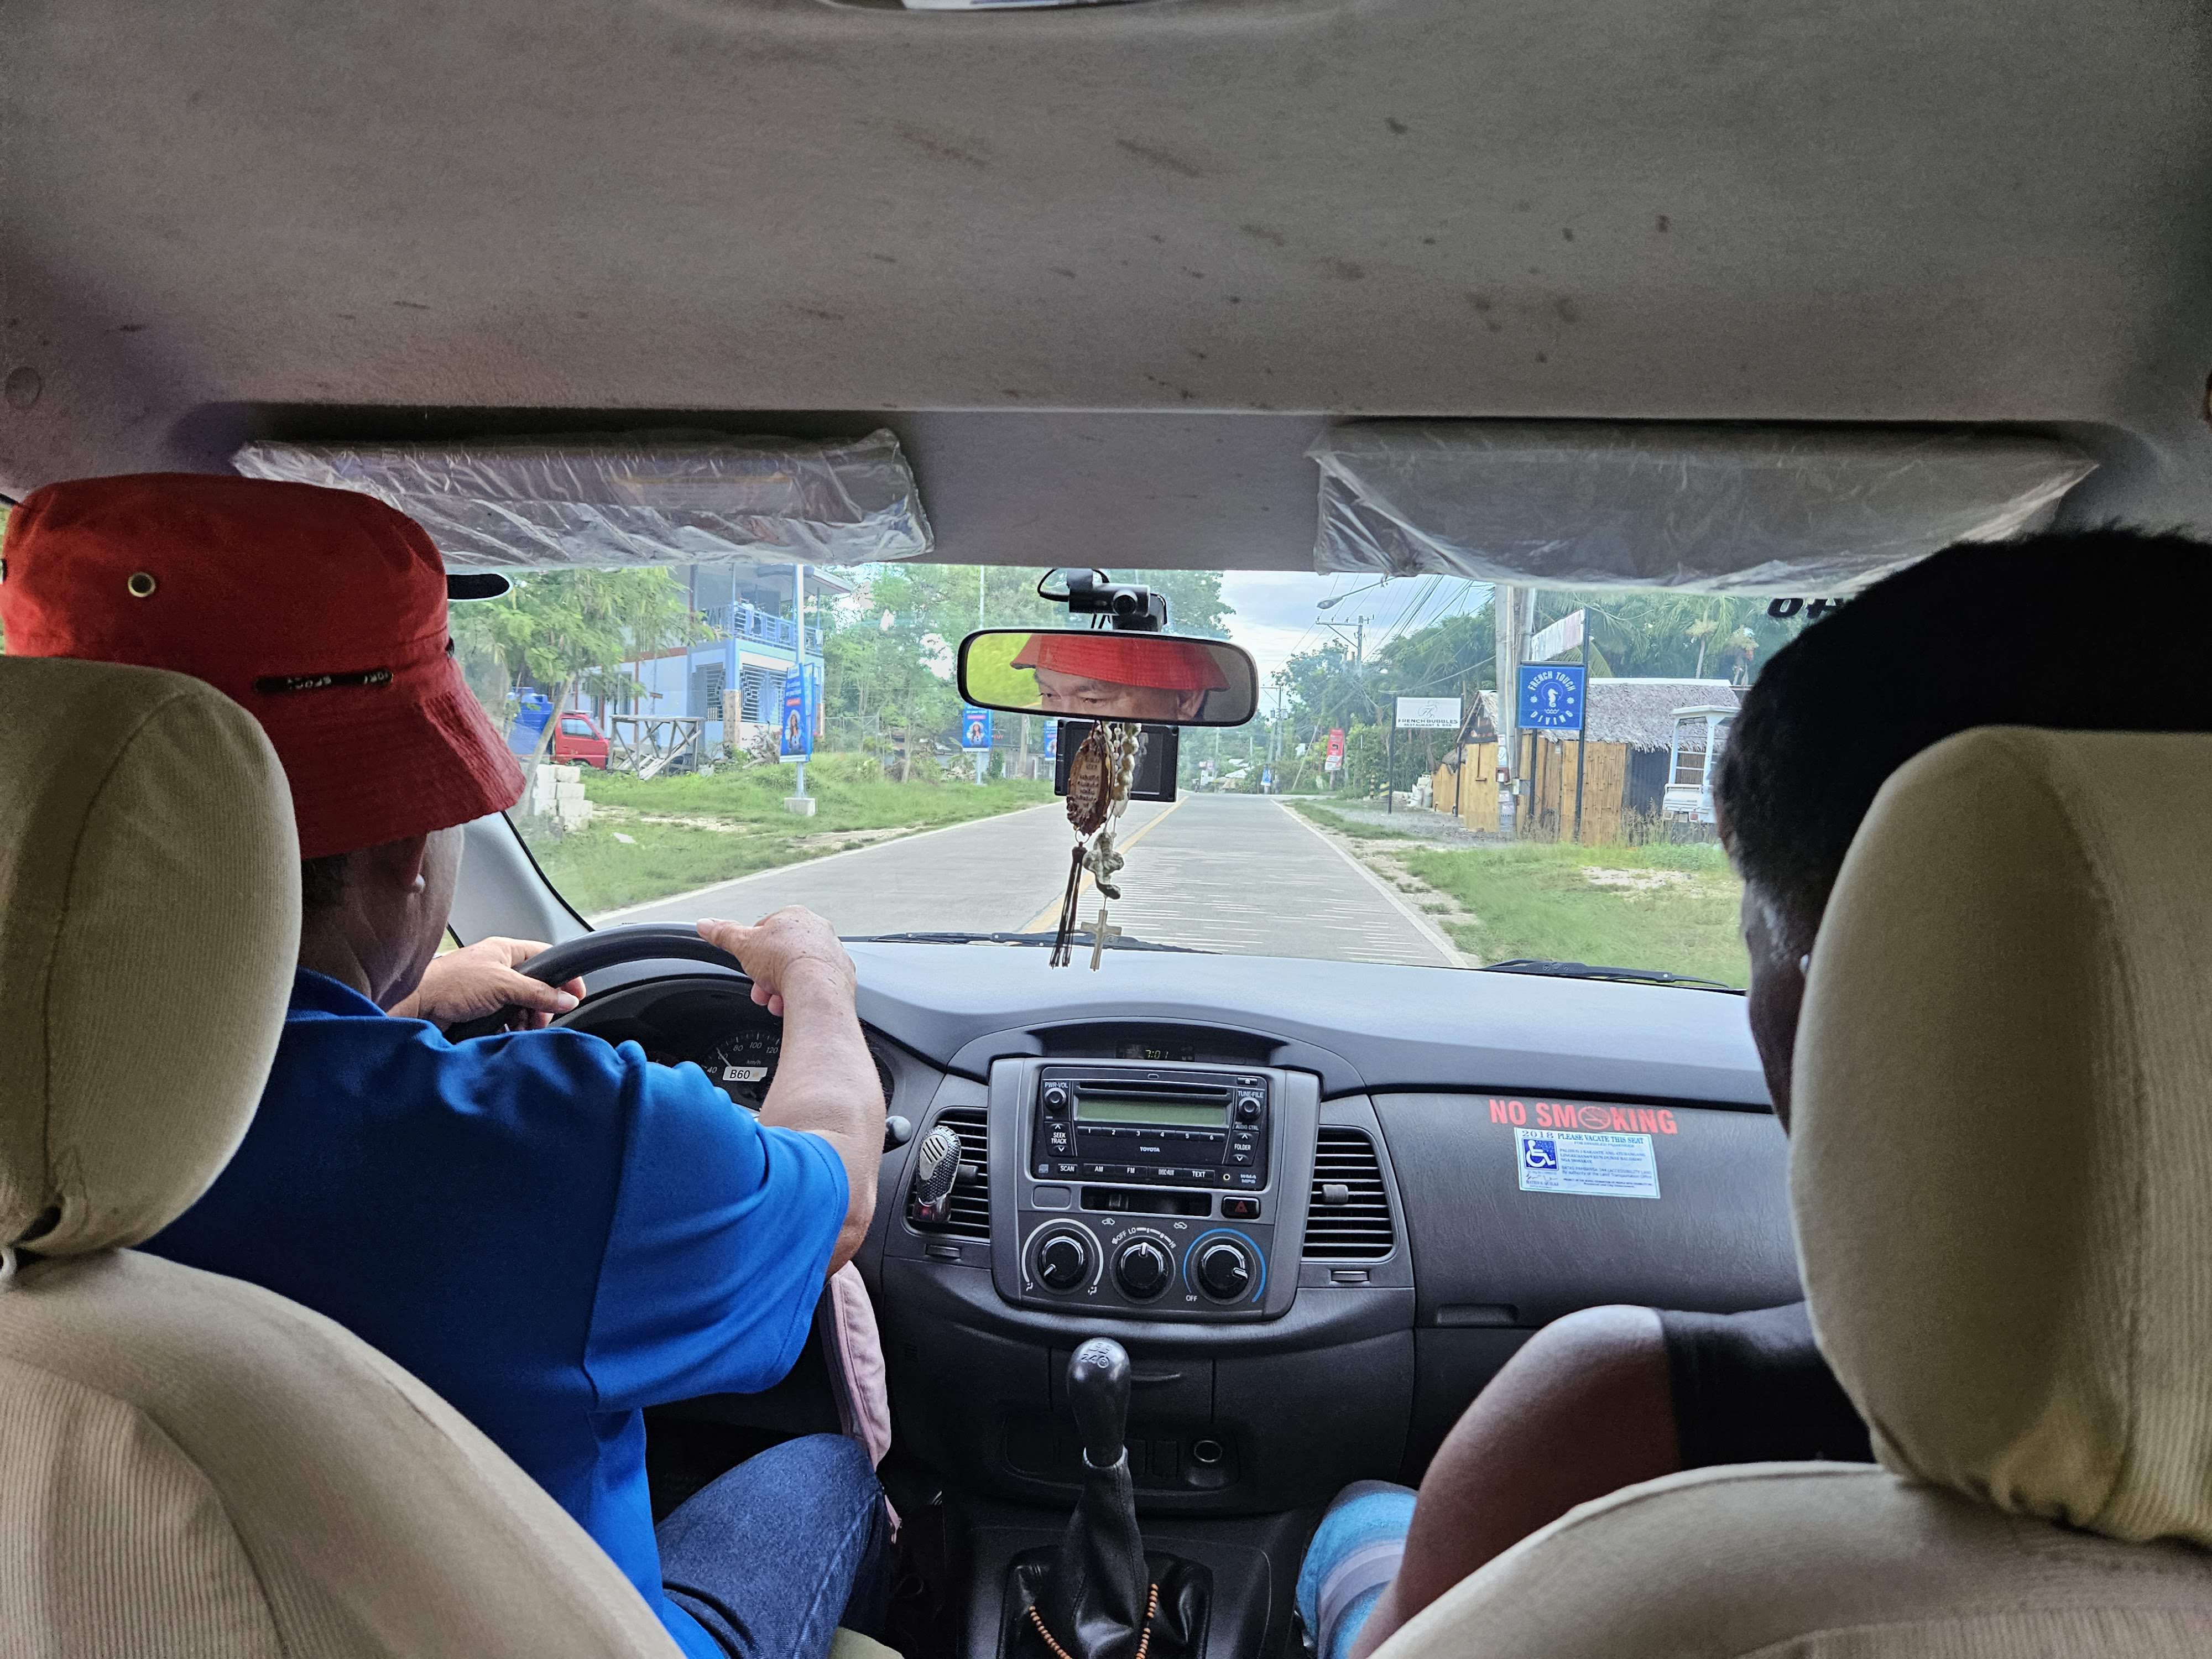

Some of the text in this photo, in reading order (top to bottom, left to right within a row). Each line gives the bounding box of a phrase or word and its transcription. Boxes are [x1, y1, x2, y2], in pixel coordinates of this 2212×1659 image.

[1527, 671, 1576, 691] FRENCH TOUCH
[1530, 710, 1573, 726] DIVING
[1145, 1050, 1168, 1059] 7:01
[729, 1070, 750, 1079] B60
[1489, 1099, 1527, 1125] NO
[1522, 1130, 1554, 1139] 2018
[1116, 1230, 1127, 1241] OFF
